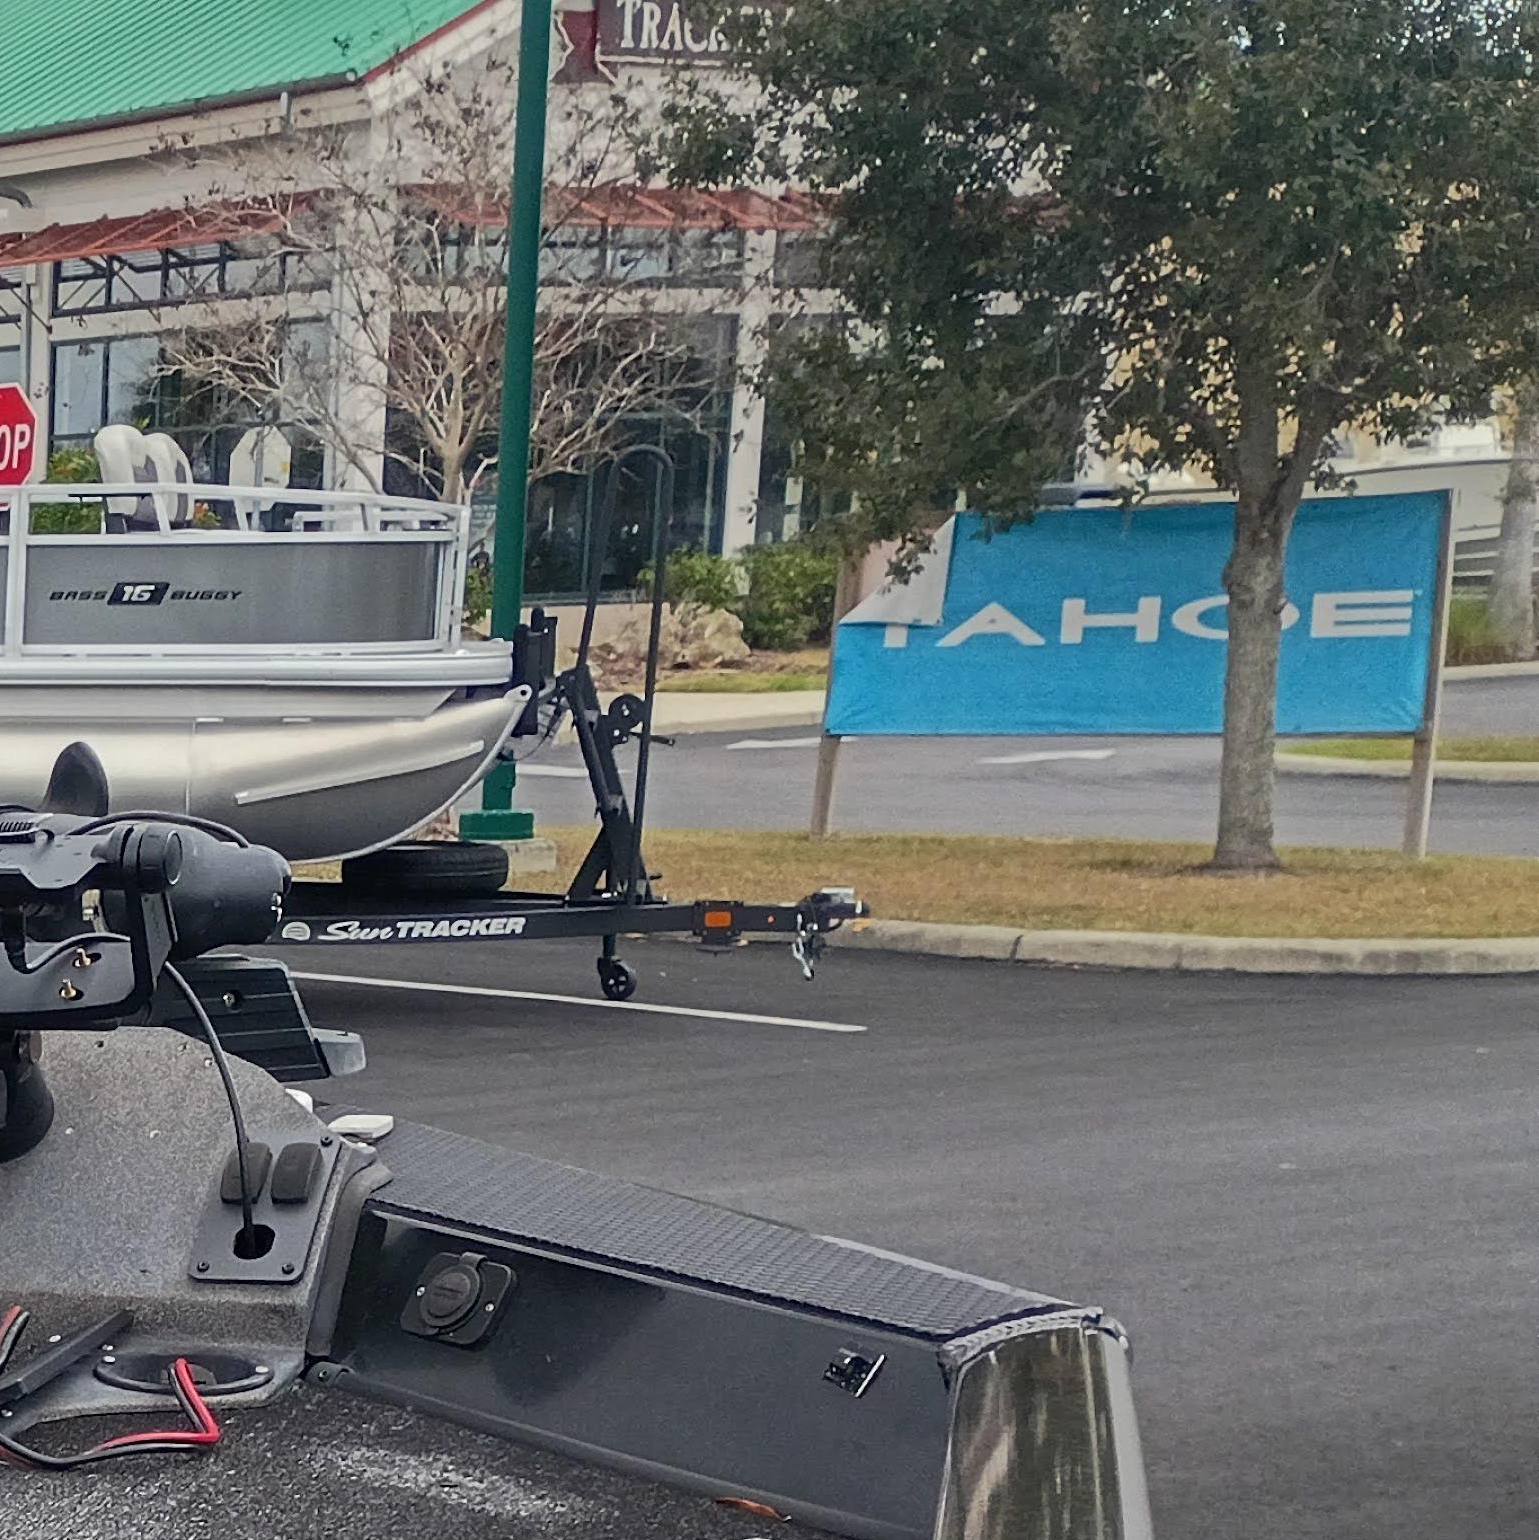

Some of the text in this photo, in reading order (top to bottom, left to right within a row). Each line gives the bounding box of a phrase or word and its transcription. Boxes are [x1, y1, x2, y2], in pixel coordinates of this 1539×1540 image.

[49, 584, 243, 602] BASS 16 BUGGY
[317, 916, 527, 941] Sun TRACKER
